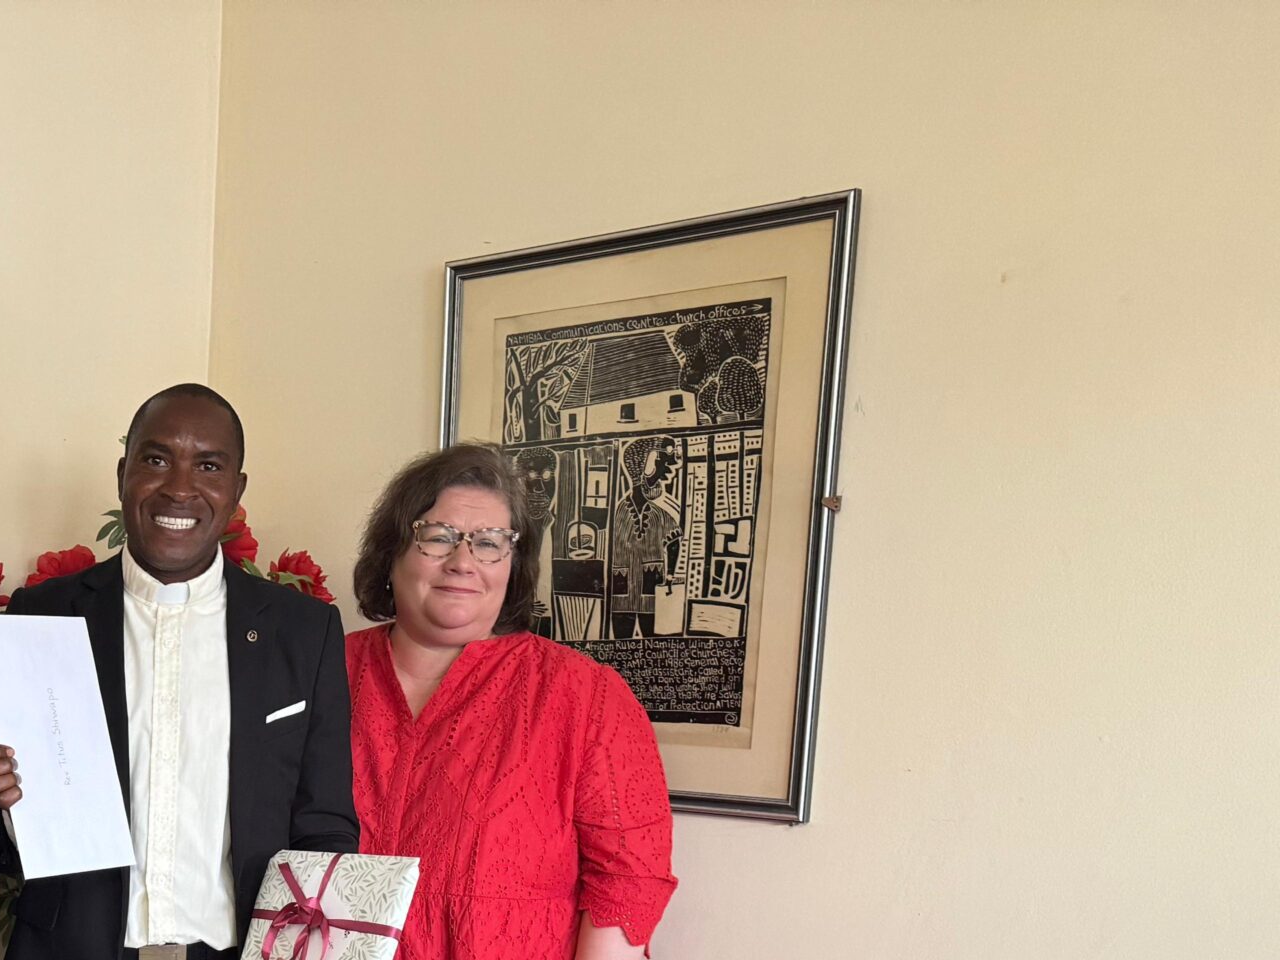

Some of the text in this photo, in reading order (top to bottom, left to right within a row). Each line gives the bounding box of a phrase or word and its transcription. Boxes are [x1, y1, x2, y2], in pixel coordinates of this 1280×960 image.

[615, 640, 643, 650] Ruled
[645, 639, 686, 650] Namibia
[645, 650, 679, 659] Council
